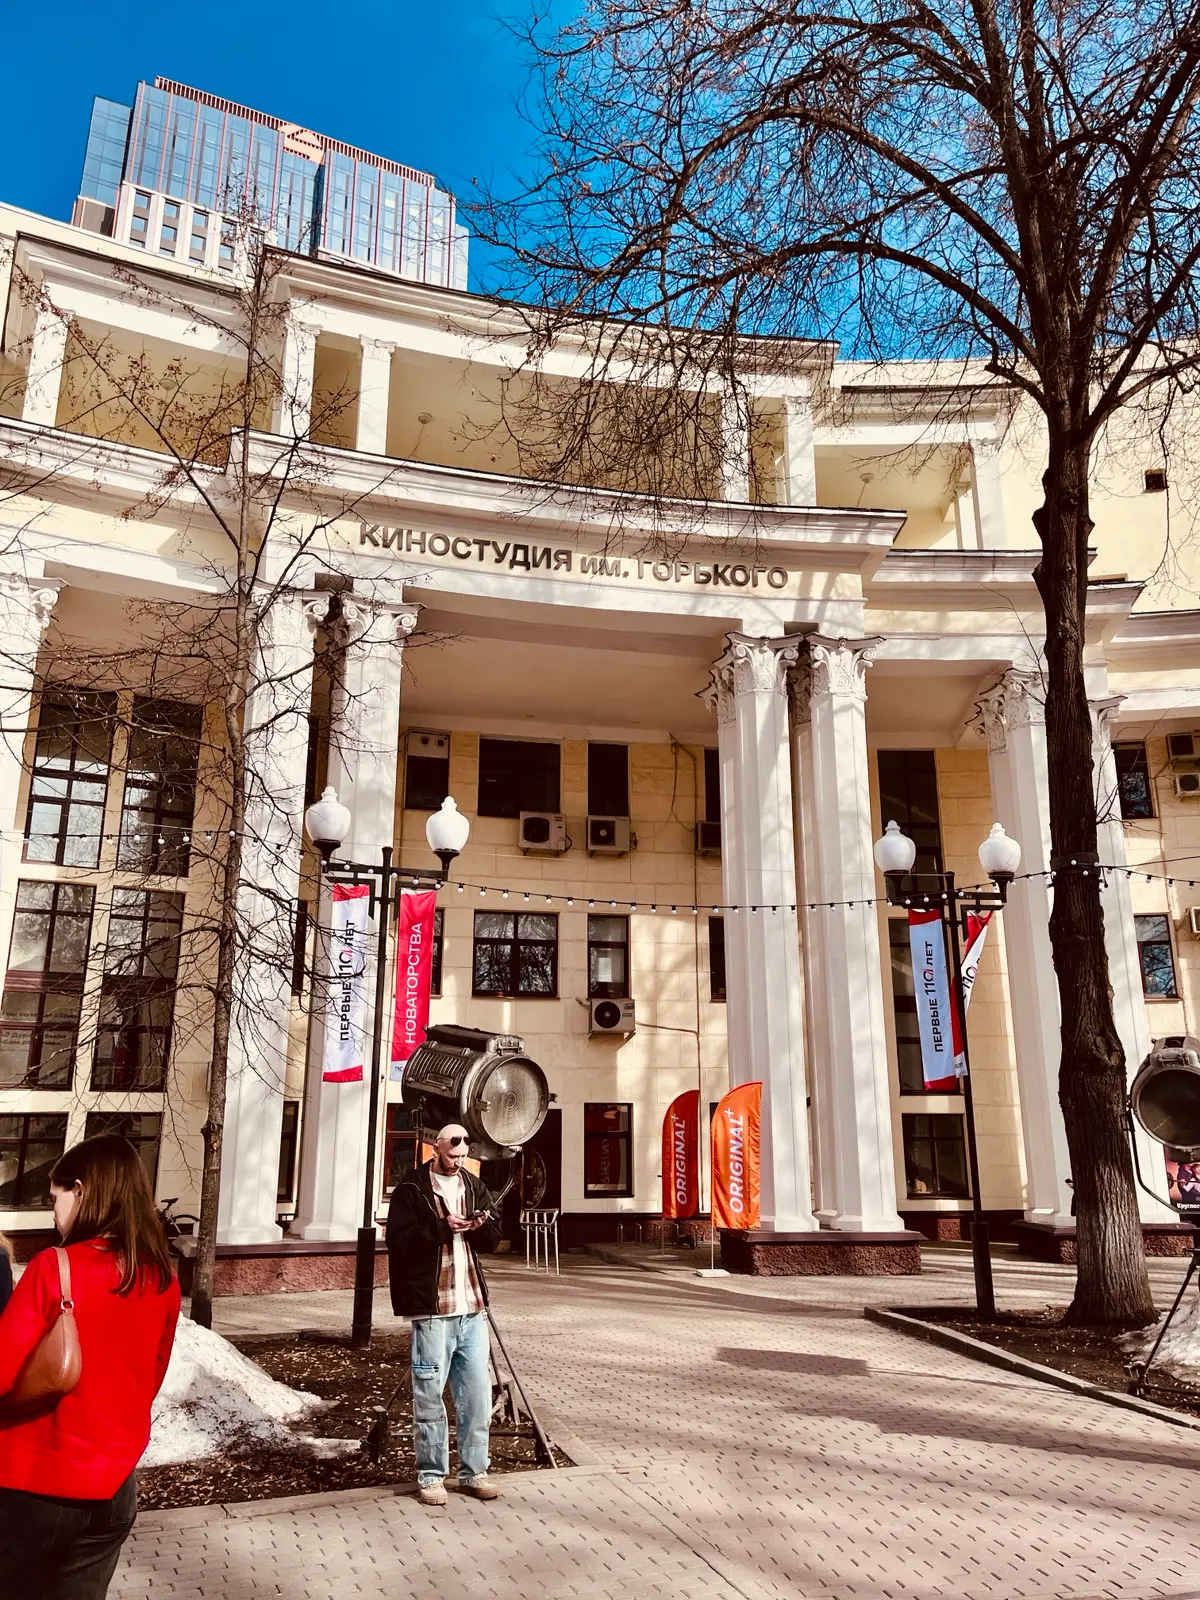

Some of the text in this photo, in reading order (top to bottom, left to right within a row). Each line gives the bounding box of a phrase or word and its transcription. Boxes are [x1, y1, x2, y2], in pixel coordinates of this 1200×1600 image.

[359, 523, 572, 572] КИНОСТУДИЯ
[637, 558, 788, 589] ГОРЬКОГО
[339, 950, 353, 978] 110
[406, 923, 422, 1043] НОВАТОРСТВА
[922, 941, 943, 1052] ПЕРВЫЕ 110 ЛЕТ
[339, 982, 352, 1041] ПЕРВЫЕ
